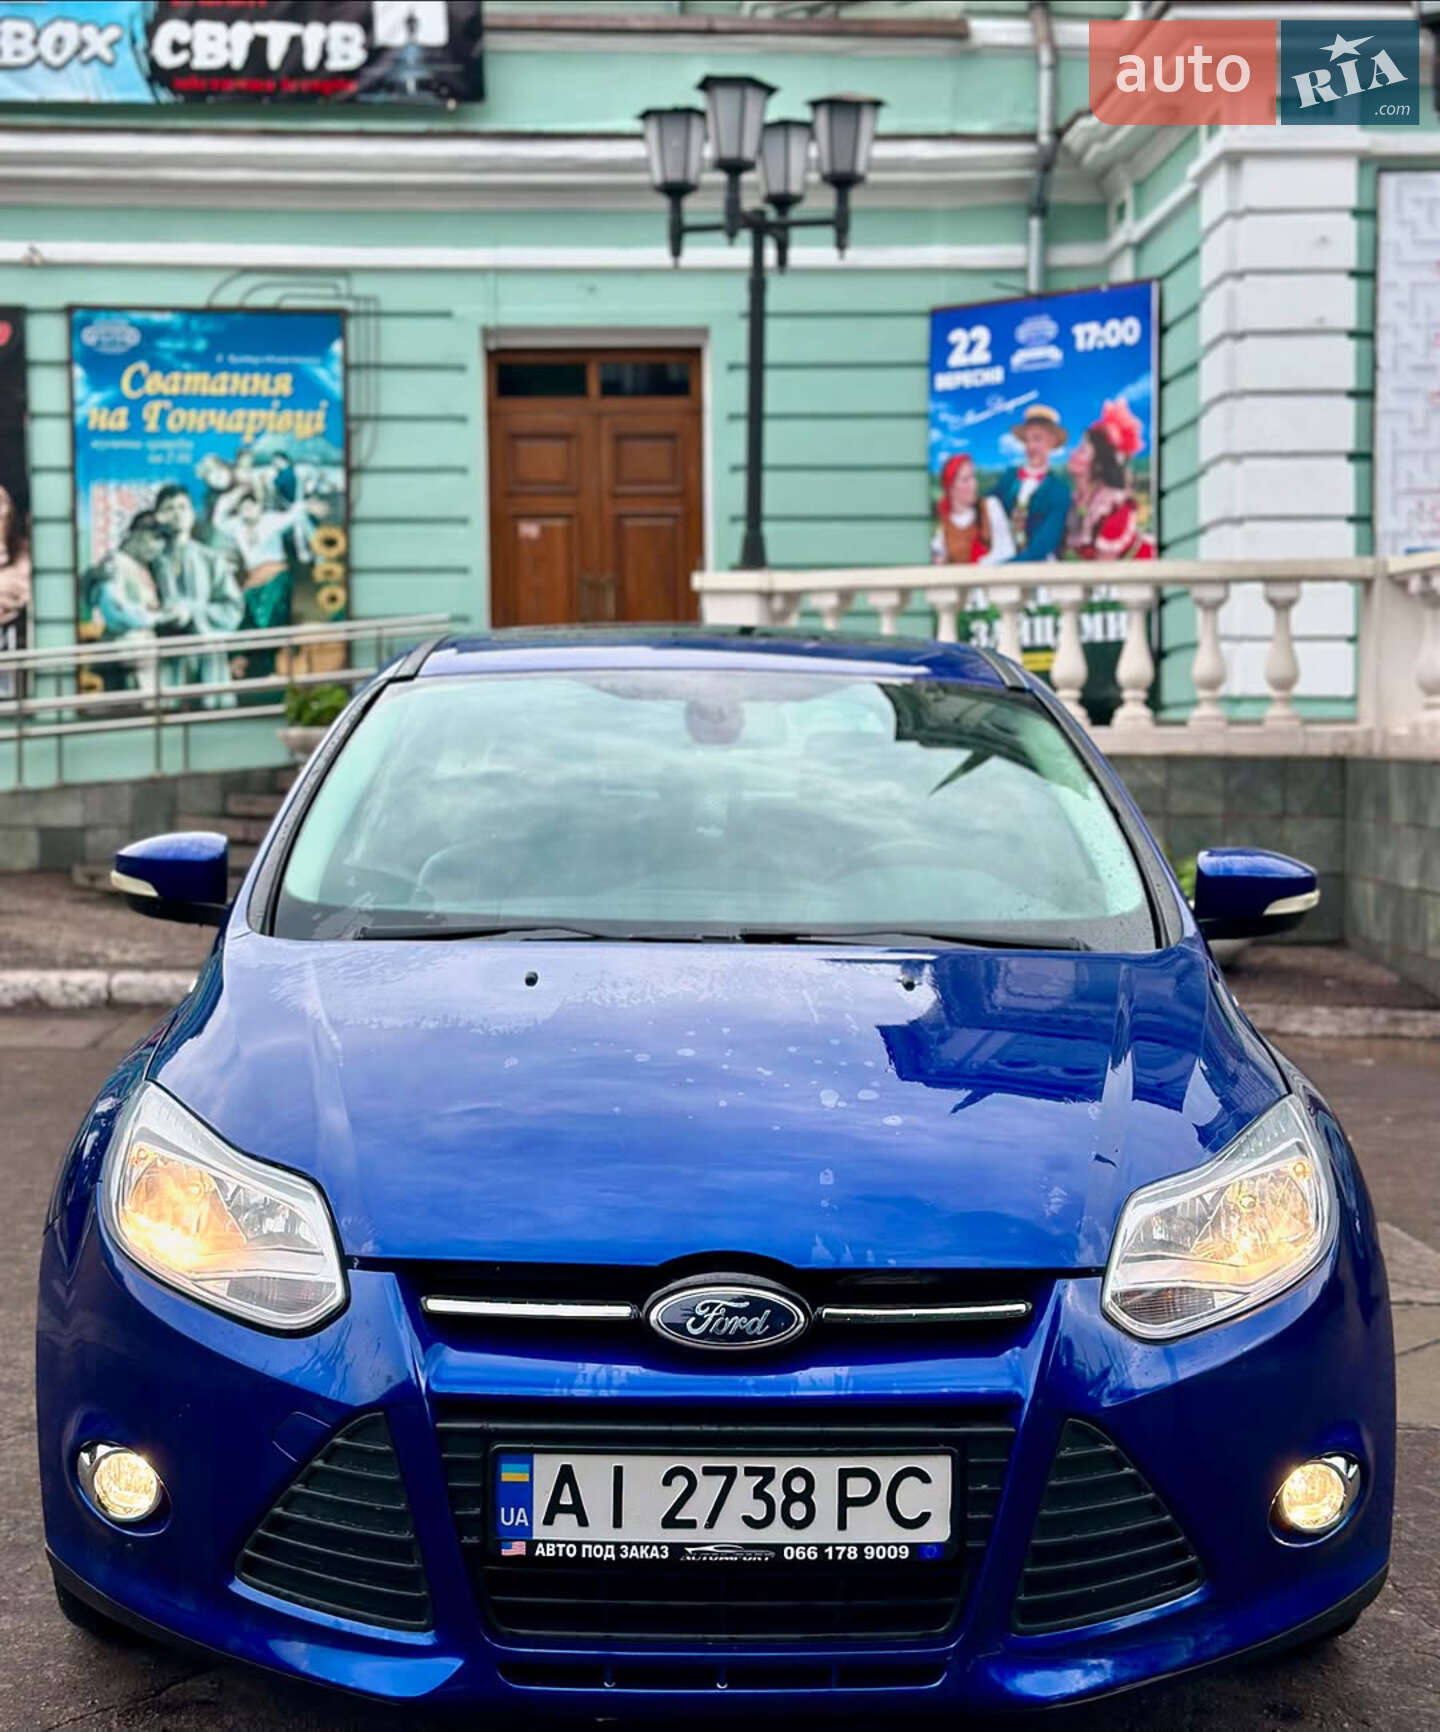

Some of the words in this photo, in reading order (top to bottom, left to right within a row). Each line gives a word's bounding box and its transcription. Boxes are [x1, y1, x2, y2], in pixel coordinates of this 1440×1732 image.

[152, 19, 368, 71] СВІТІВ
[947, 325, 992, 368] 22
[1072, 316, 1141, 351] 17:00
[120, 360, 293, 399] Сватання
[88, 406, 129, 431] на
[142, 399, 328, 444] Гончарівці
[686, 1300, 771, 1335] Ford
[500, 1507, 529, 1526] UA
[661, 1465, 816, 1530] 2738
[837, 1467, 932, 1531] PC
[535, 1543, 577, 1557] АВТО
[581, 1544, 616, 1560] ПОД
[619, 1545, 669, 1559] ЗАКАЗ
[783, 1546, 818, 1560] 066
[824, 1546, 858, 1560] 178
[863, 1545, 909, 1559] 9009
